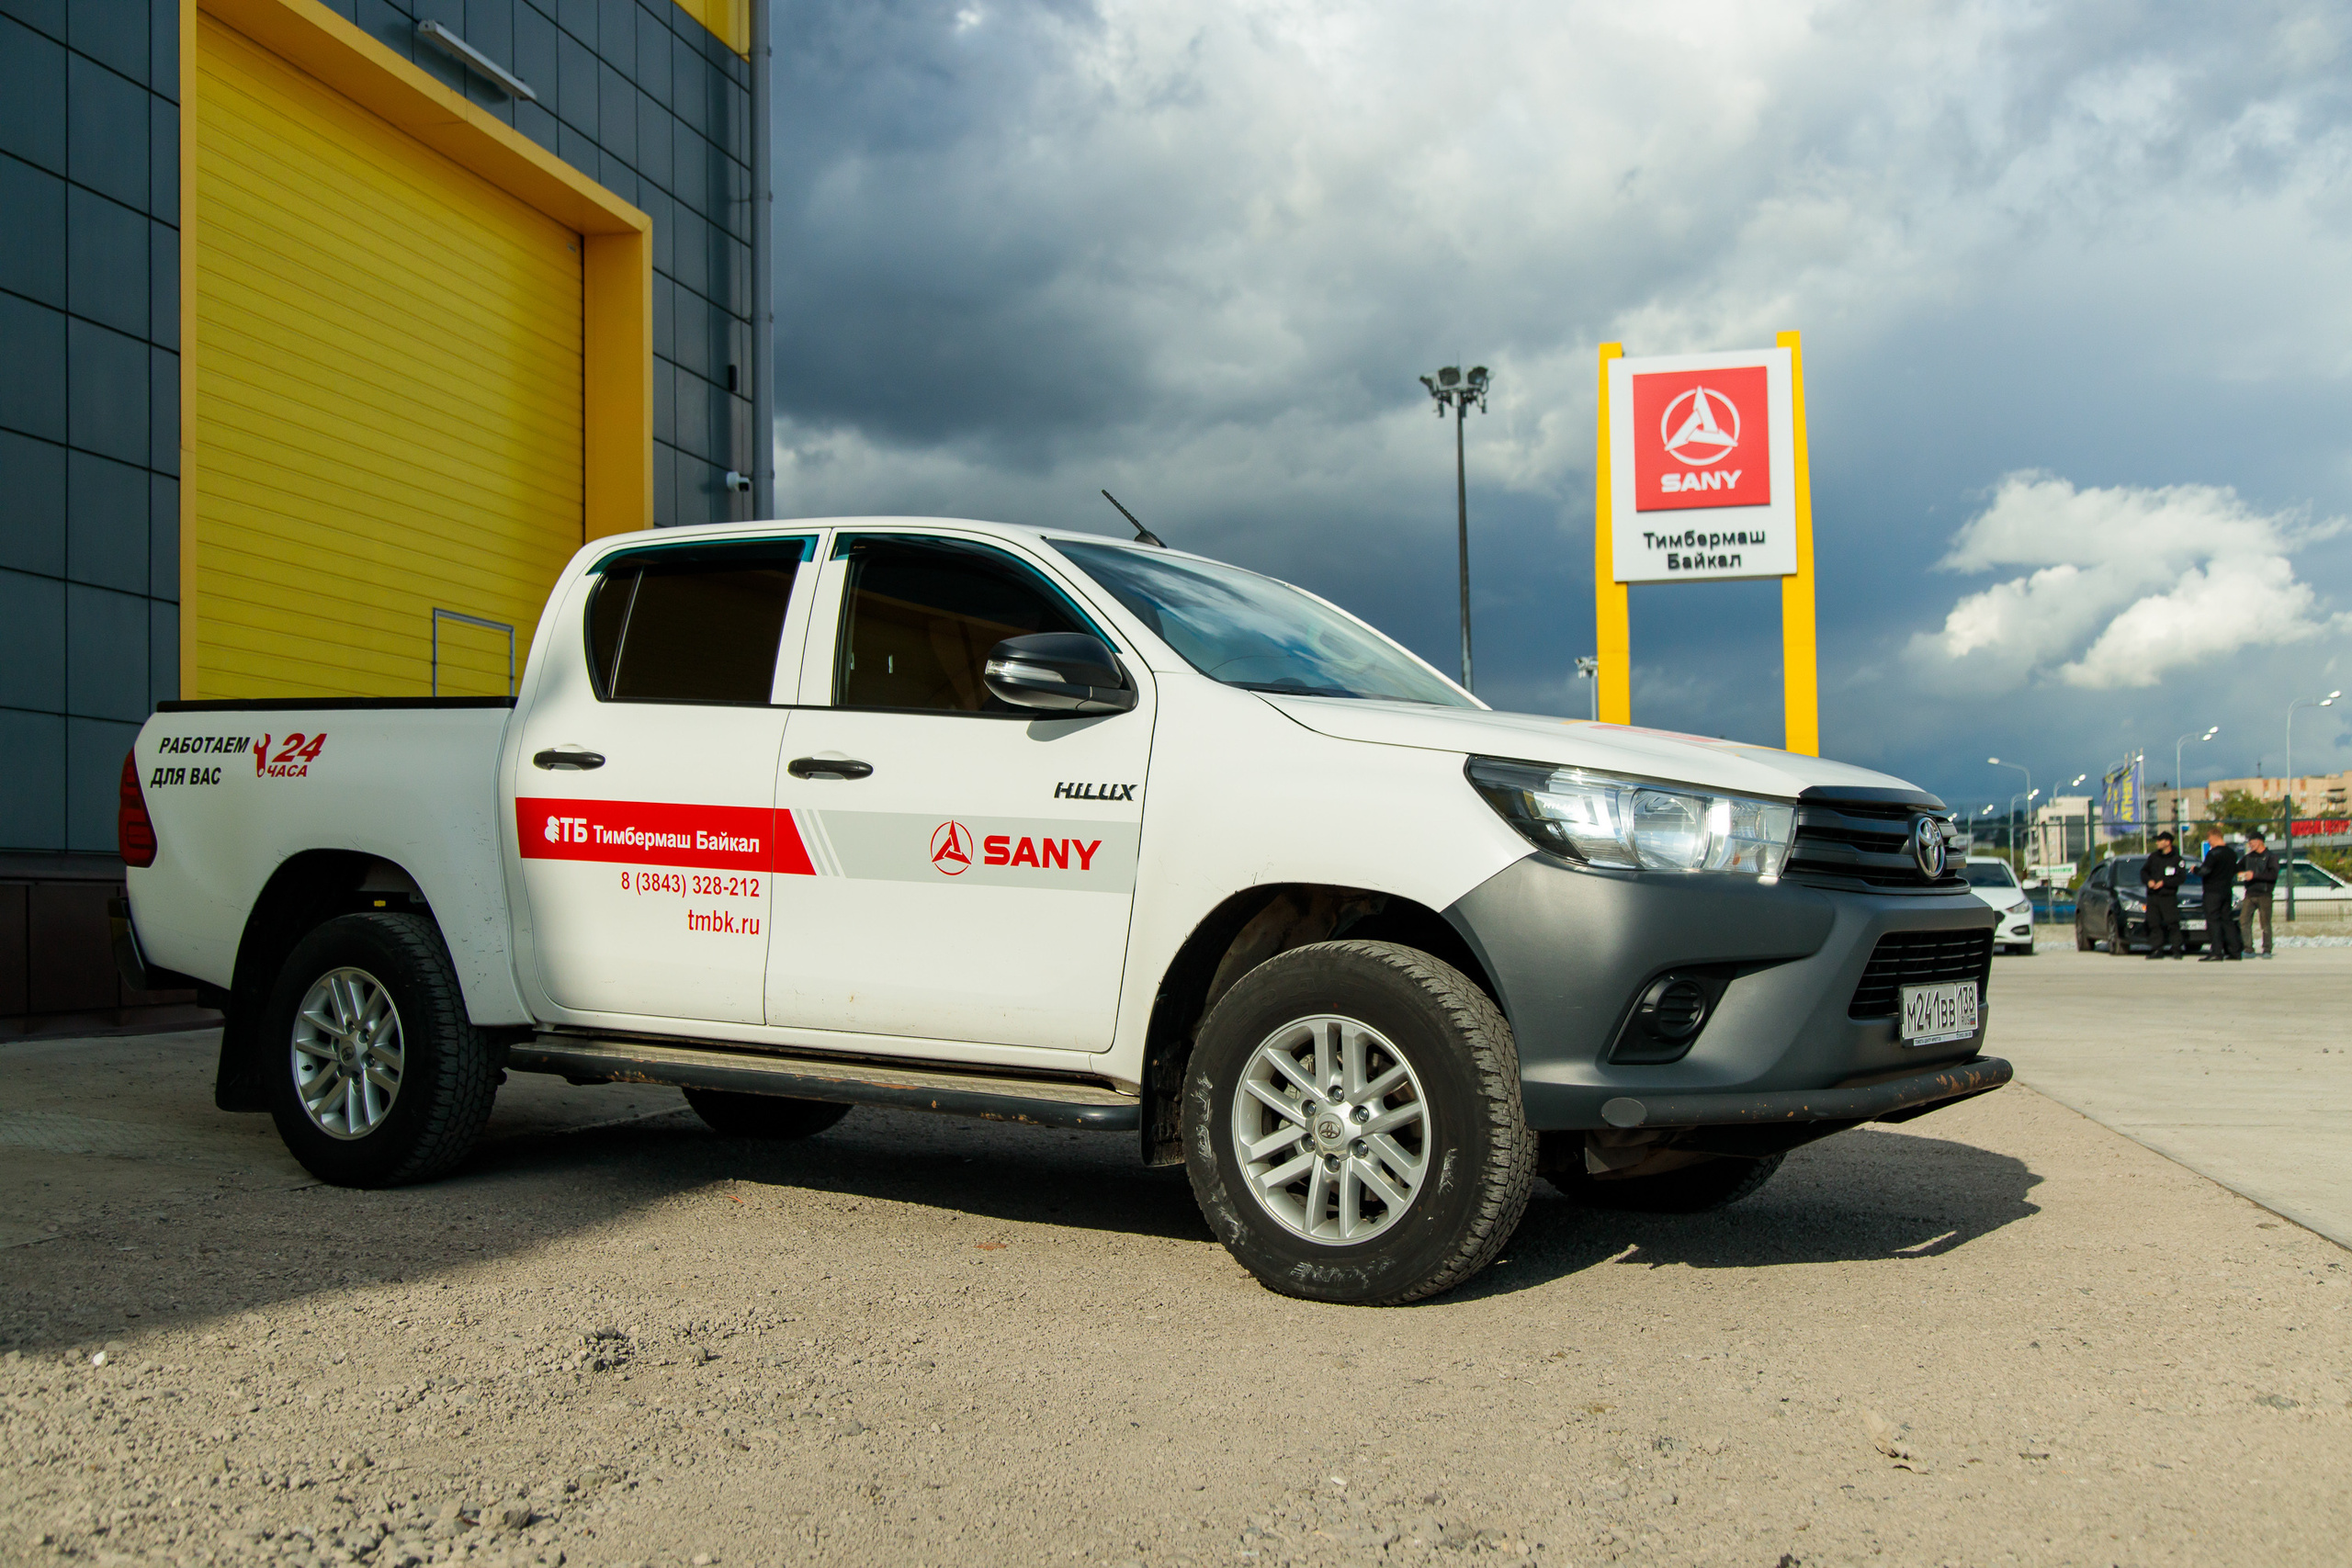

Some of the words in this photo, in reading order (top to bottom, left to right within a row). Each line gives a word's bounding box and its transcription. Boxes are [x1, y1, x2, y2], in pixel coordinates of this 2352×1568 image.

[1660, 469, 1742, 493] SANY
[1643, 530, 1766, 549] Тимбермаш
[1667, 553, 1742, 570] Байкал
[158, 737, 251, 754] РАБОТАЕМ
[272, 733, 328, 763] 24
[150, 767, 187, 788] ДЛЯ
[189, 767, 222, 785] ВАС
[266, 765, 309, 778] ЧАСА
[1054, 782, 1138, 801] HILUX
[560, 817, 588, 843] ТБ
[593, 825, 691, 851] Тимбермаш
[696, 830, 760, 853] Байкал
[983, 835, 1102, 872] SANY
[621, 872, 630, 890] 8
[636, 873, 686, 898] (3843)
[692, 875, 760, 897] 328-212
[687, 909, 760, 935] tmbk.ru
[1957, 985, 1975, 1016] 138
